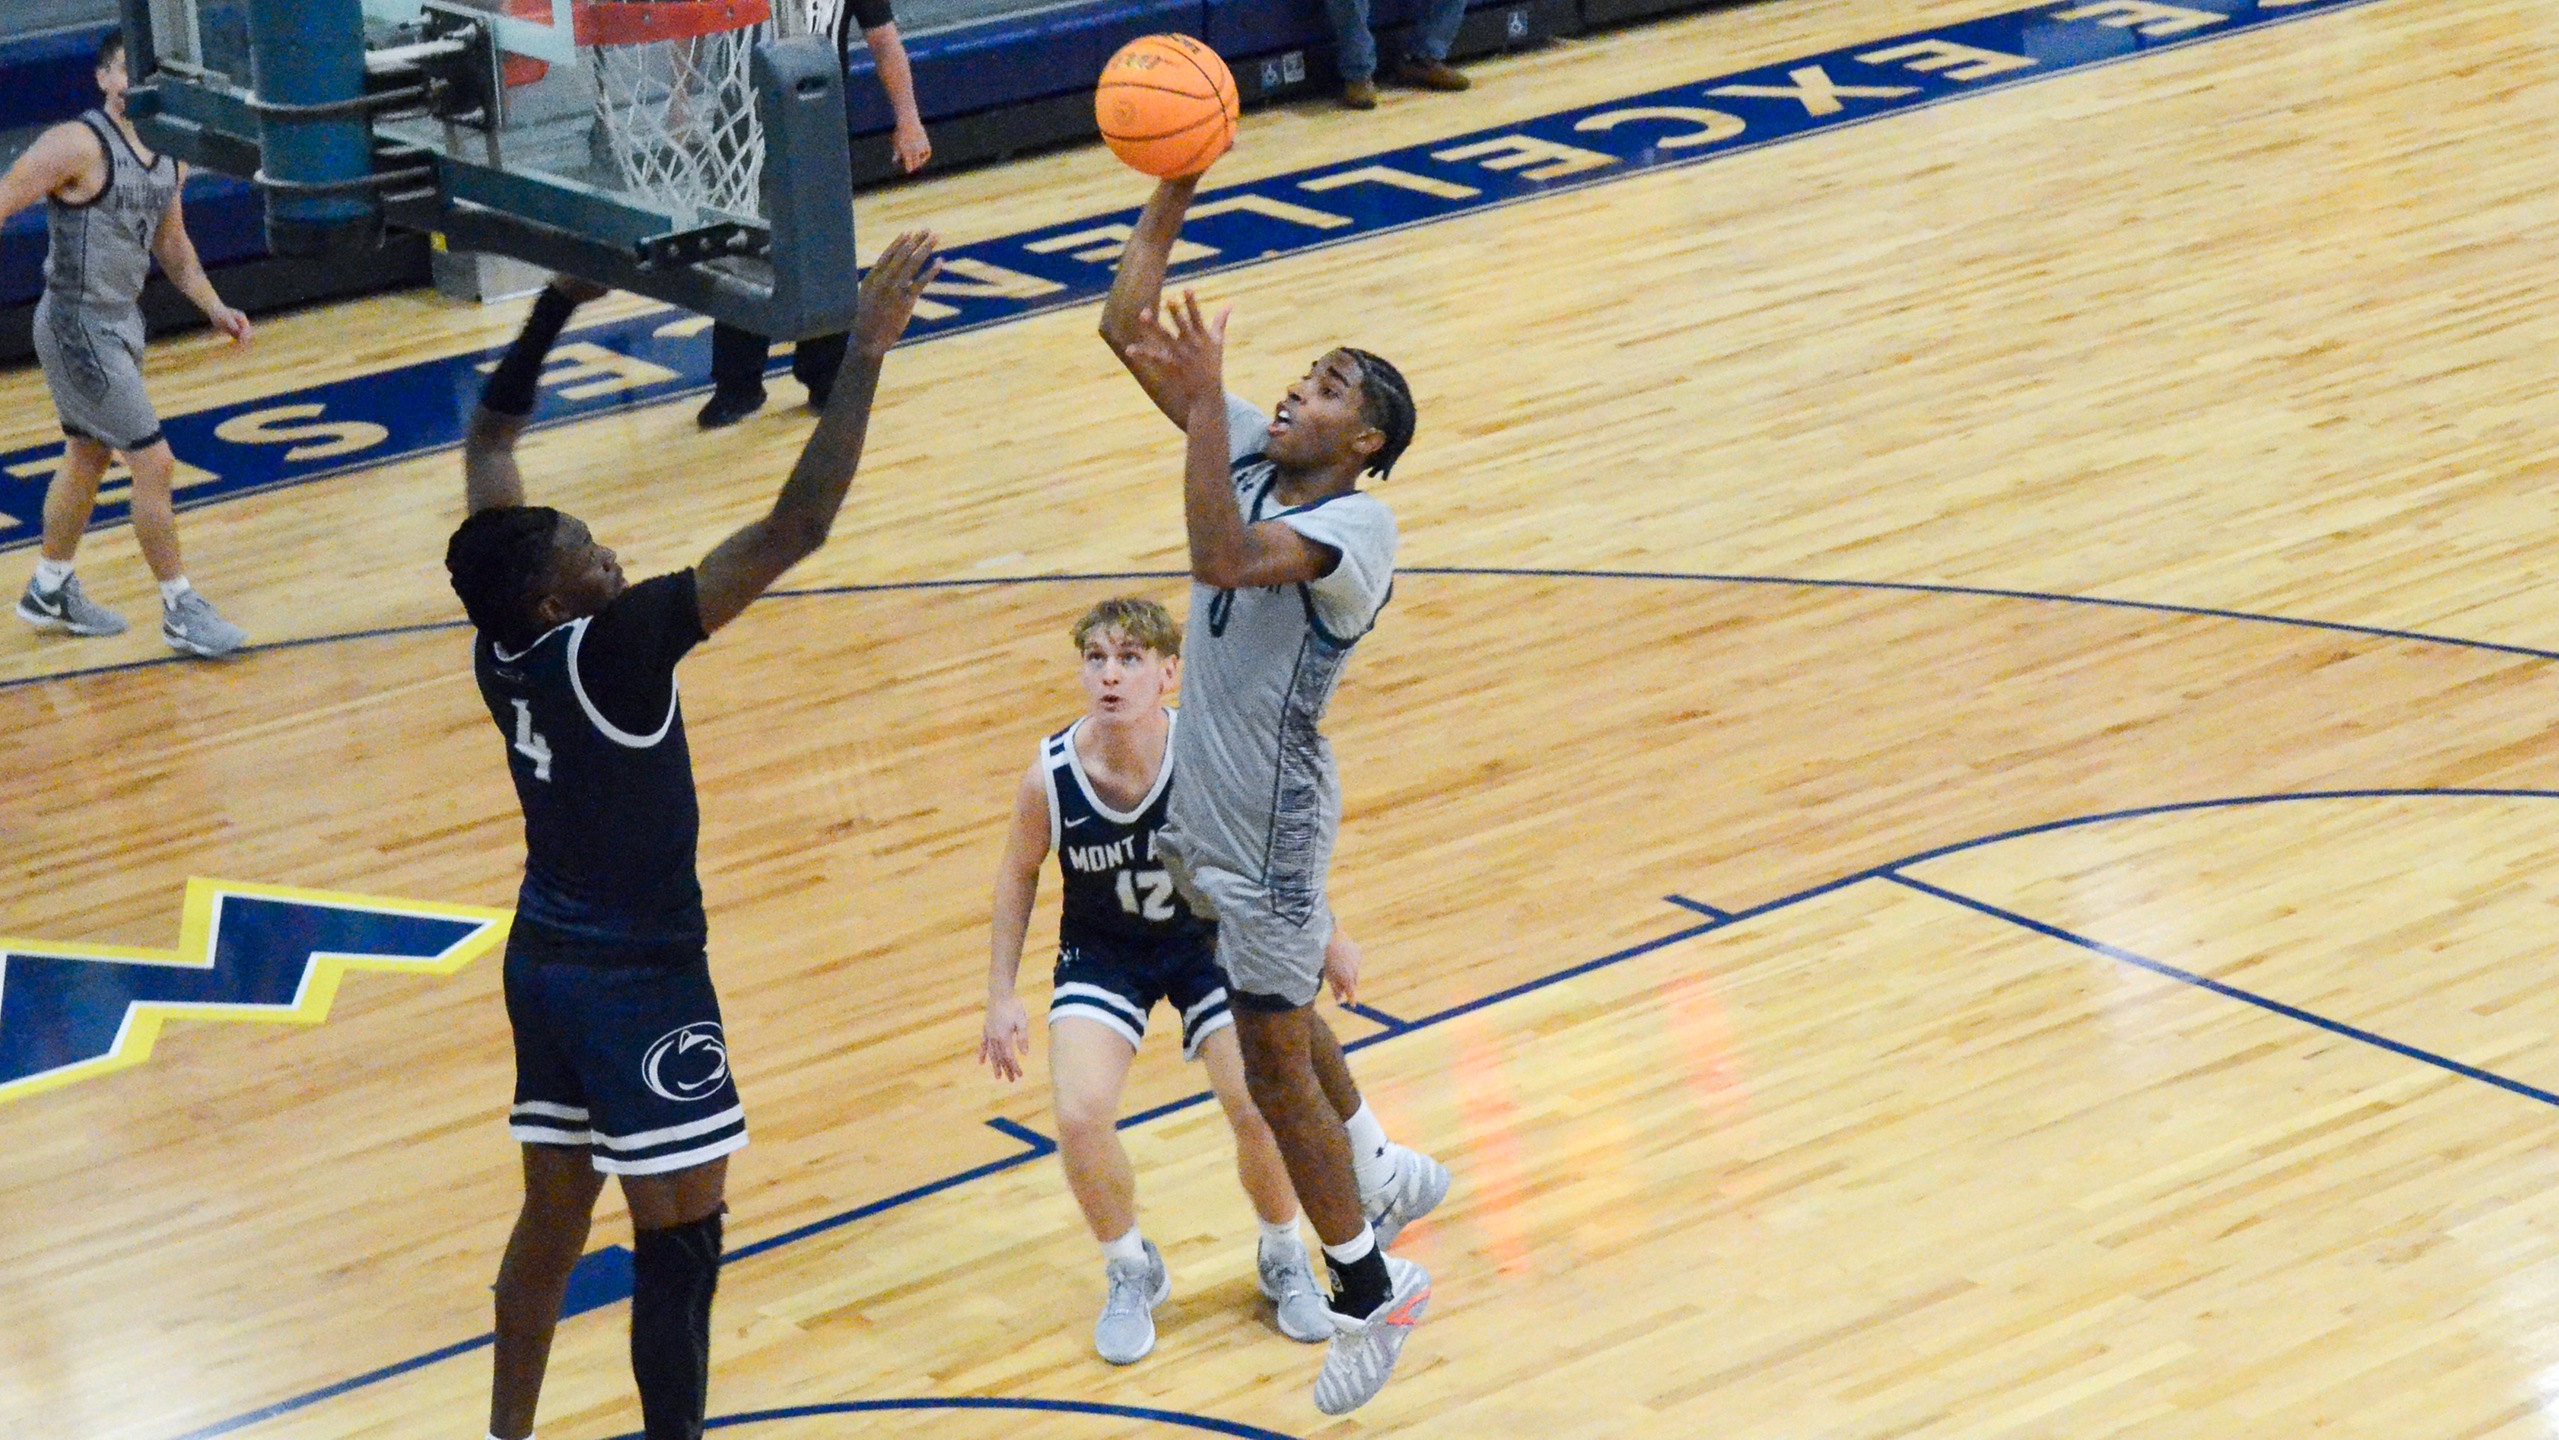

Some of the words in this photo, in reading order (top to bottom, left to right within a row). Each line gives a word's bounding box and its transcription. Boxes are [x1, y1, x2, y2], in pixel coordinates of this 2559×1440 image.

[475, 37, 2039, 401] EXCELLENE
[510, 698, 552, 782] 4
[1068, 834, 1136, 873] MONT
[1114, 868, 1175, 921] 12
